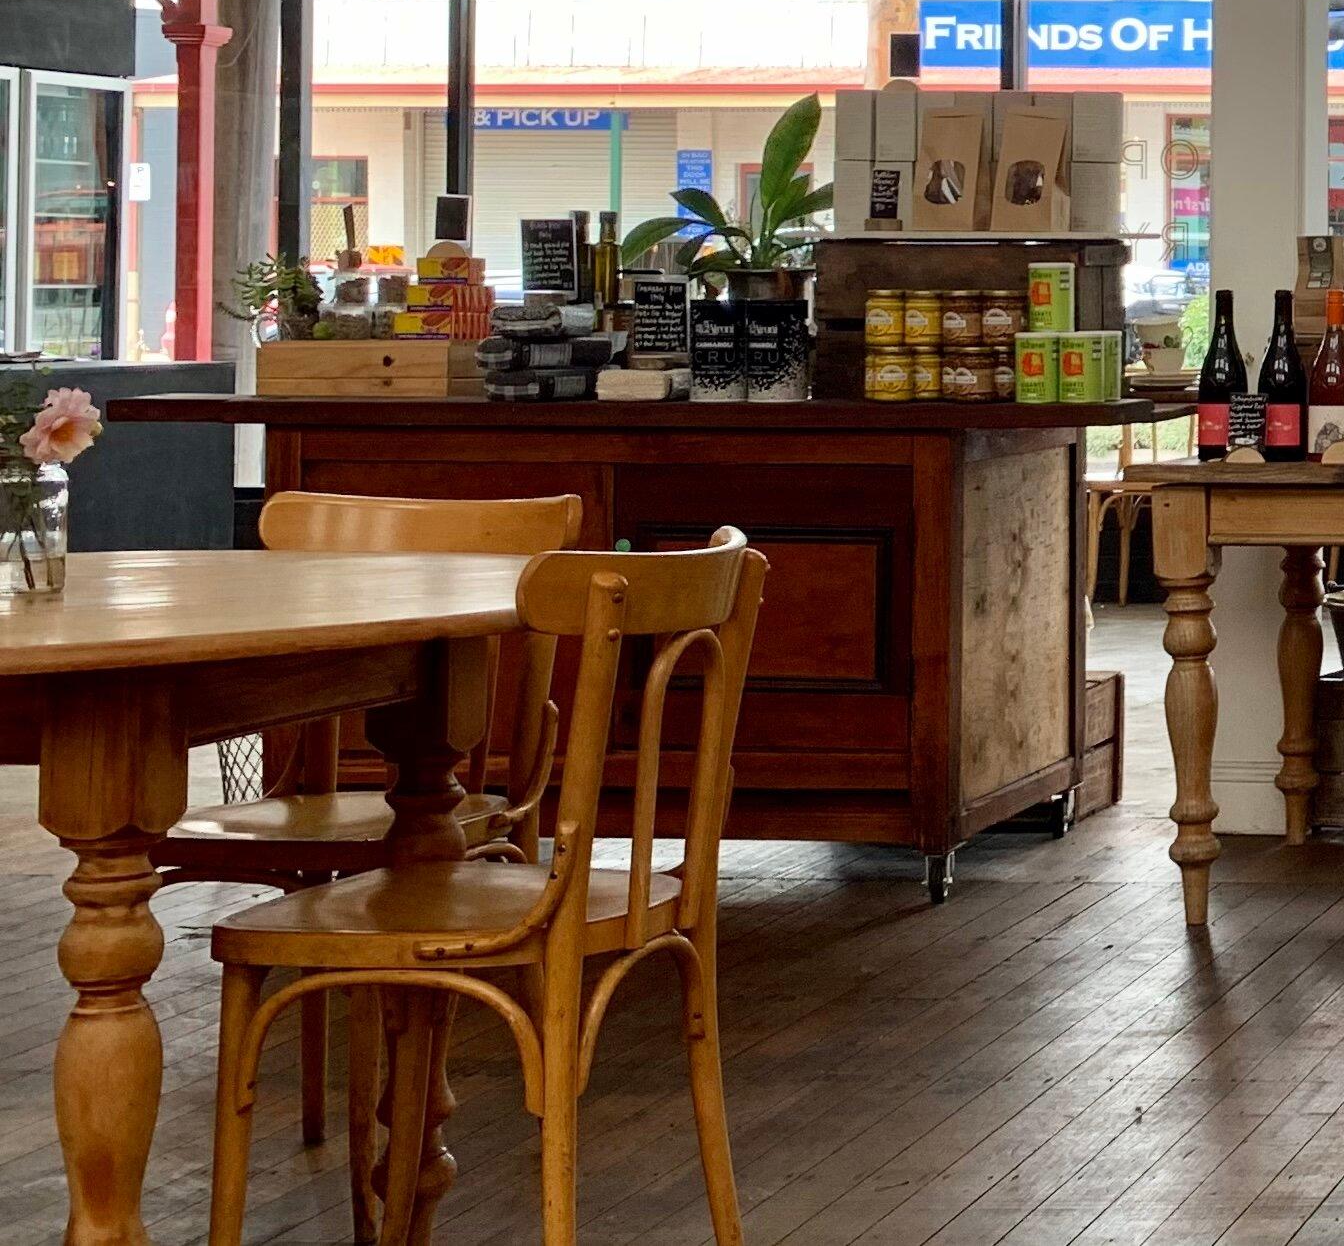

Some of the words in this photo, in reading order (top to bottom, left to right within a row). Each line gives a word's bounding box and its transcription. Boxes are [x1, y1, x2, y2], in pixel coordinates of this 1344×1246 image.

[924, 15, 1103, 51] FRINDS
[474, 109, 491, 126] &
[496, 109, 559, 127] PICK
[563, 110, 601, 127] UP
[694, 350, 737, 364] CRU
[753, 350, 780, 364] RU
